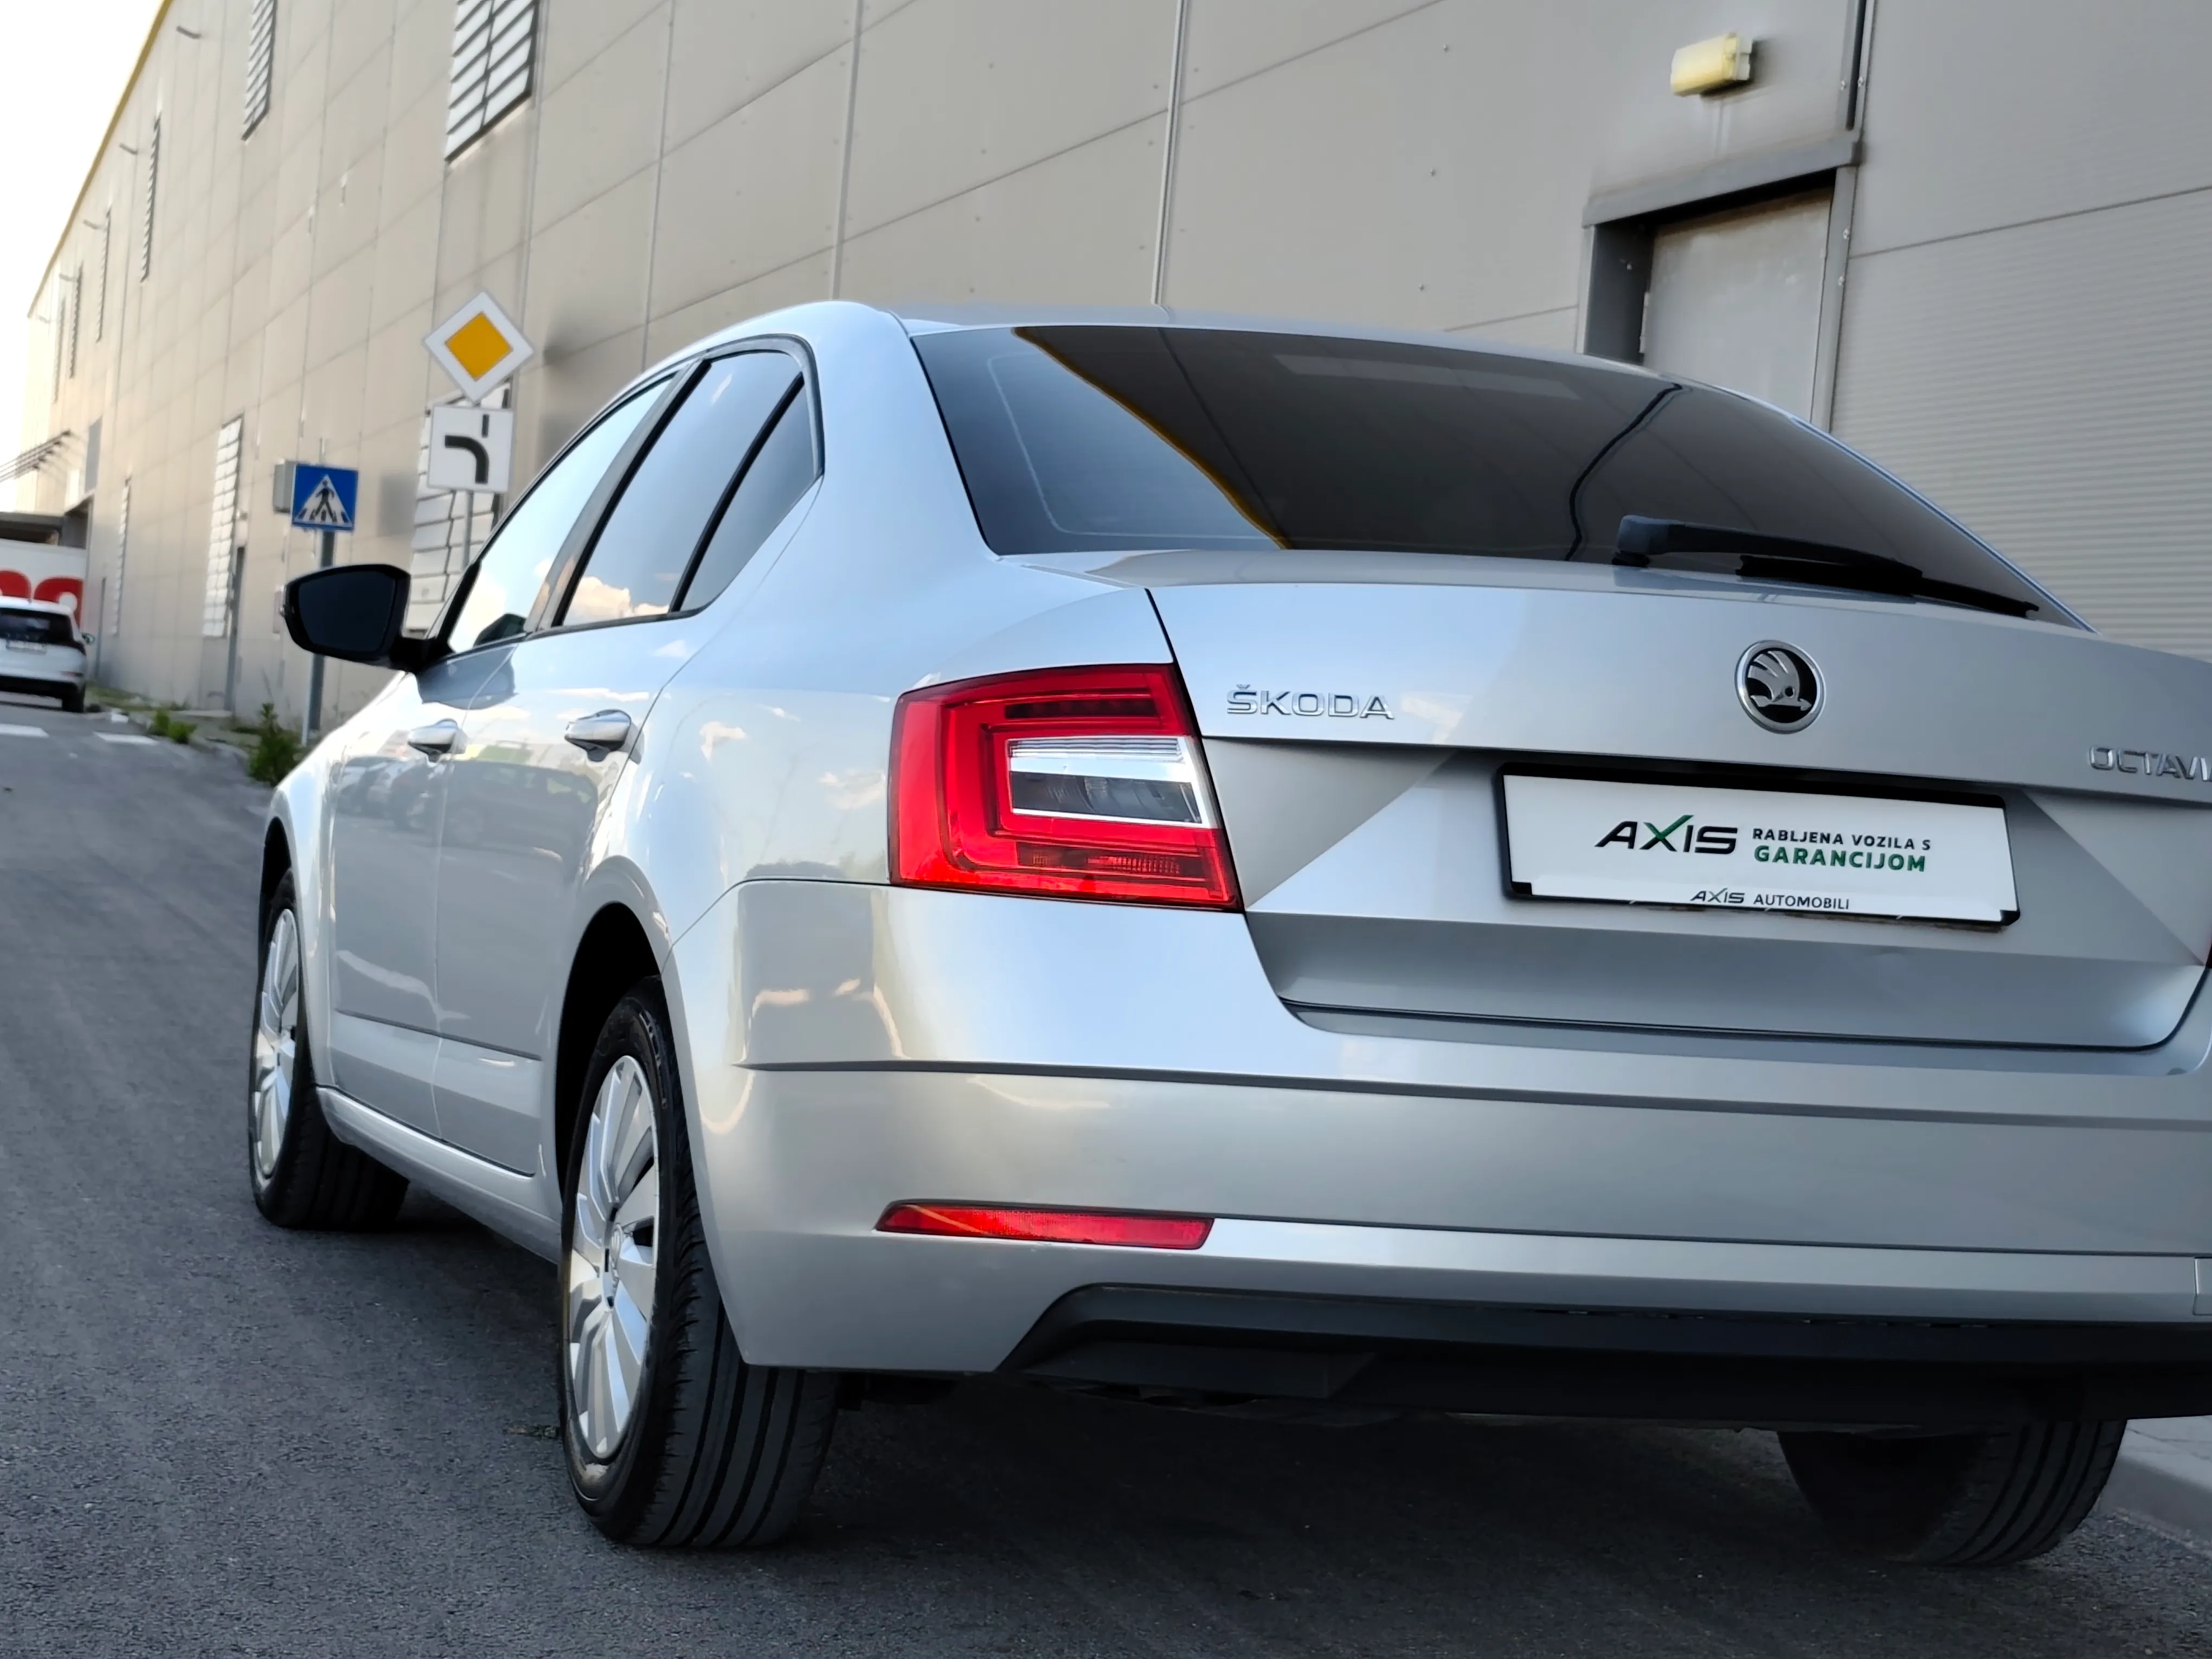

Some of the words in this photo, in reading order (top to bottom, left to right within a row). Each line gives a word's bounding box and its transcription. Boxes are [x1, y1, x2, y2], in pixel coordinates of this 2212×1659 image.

[1227, 684, 1394, 719] ŠKODA
[2089, 746, 2212, 782] OCTAVI
[1594, 814, 1738, 854] AXIS
[1752, 828, 1844, 845] RABLJENA
[1851, 834, 1915, 850] VOZILA
[1921, 839, 1931, 851] S
[1753, 845, 1926, 872] GARANCIJOM
[1690, 887, 1746, 904] AXIS
[1753, 893, 1850, 910] AUTOMOBILI
